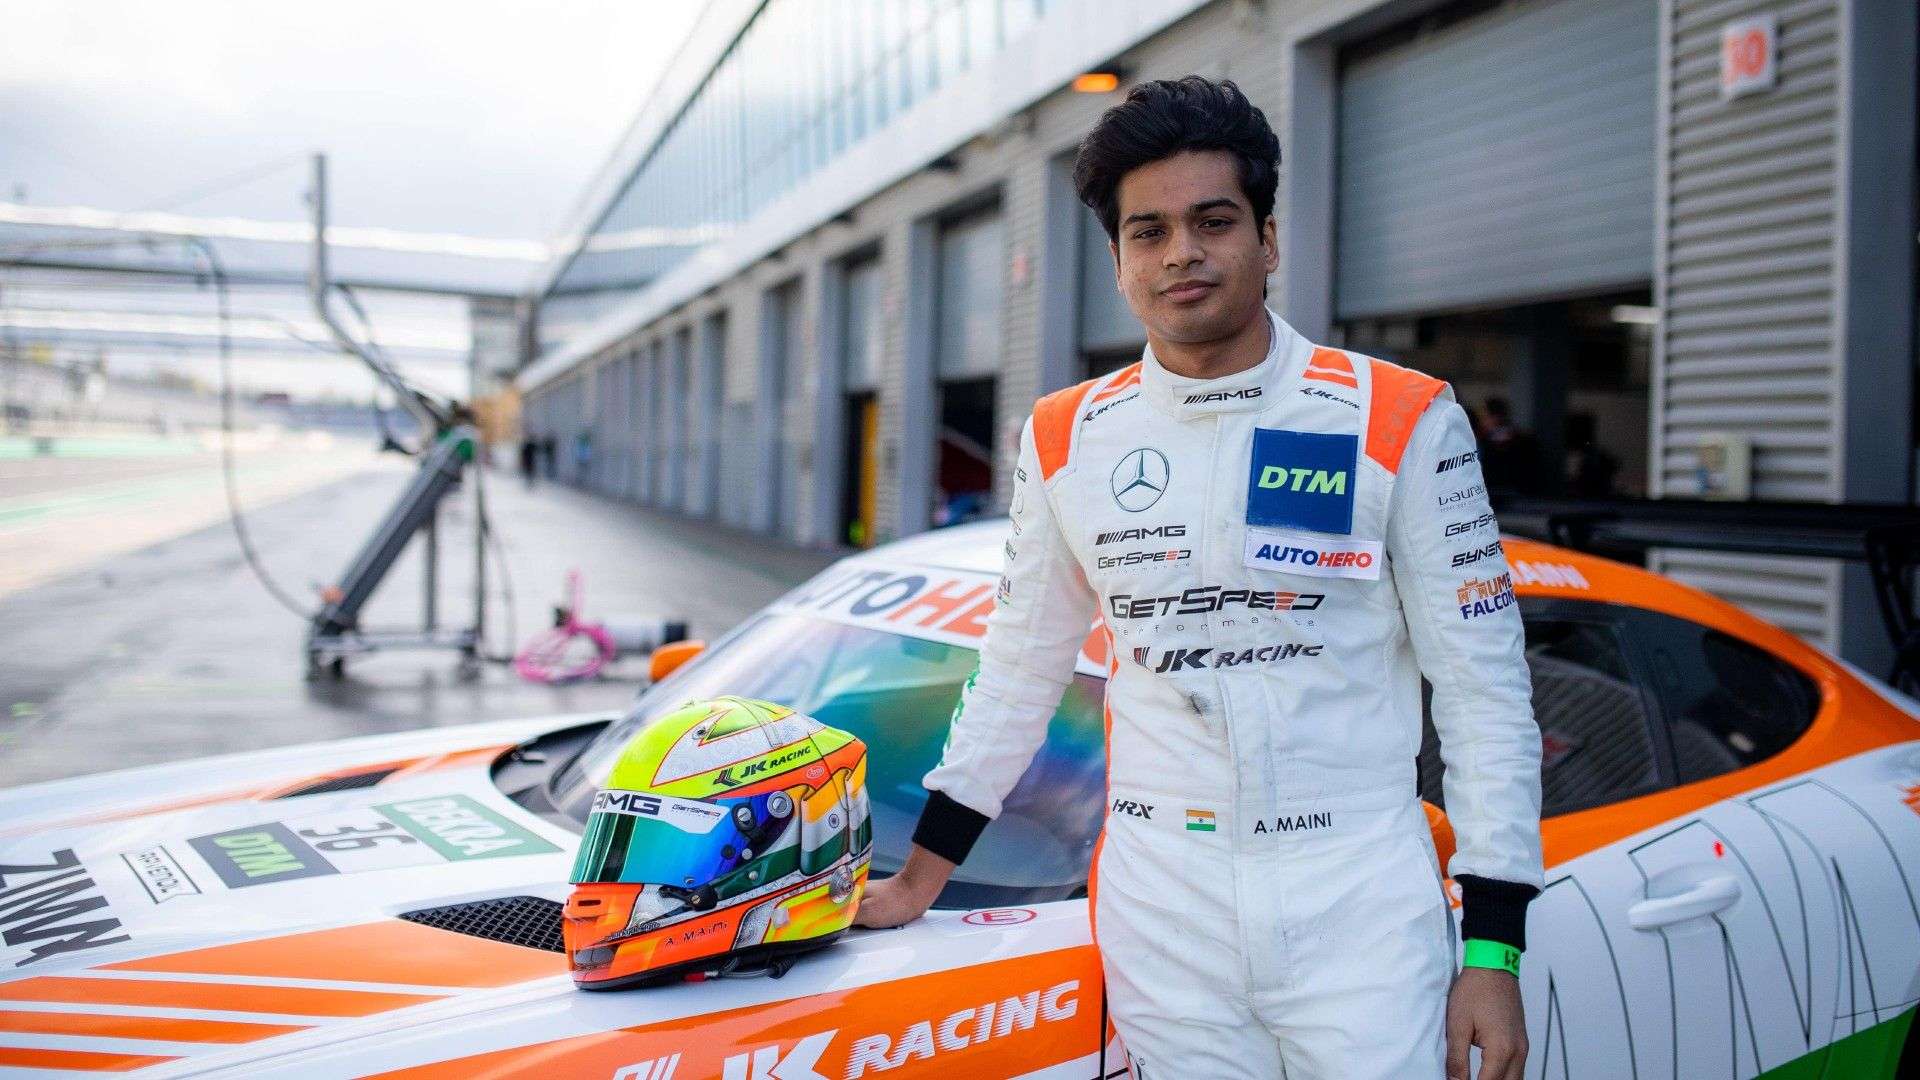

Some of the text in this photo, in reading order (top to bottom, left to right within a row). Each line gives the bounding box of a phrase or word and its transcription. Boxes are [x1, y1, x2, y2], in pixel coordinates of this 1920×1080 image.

[1258, 465, 1347, 495] DTM
[1255, 543, 1373, 569] AUTOHERO
[1452, 541, 1504, 568] SYNER
[1460, 590, 1516, 620] FALCON
[1156, 644, 1324, 673] JK RACING
[740, 746, 811, 778] JK RACING
[1113, 799, 1155, 820] HRX
[299, 821, 417, 851] 36
[214, 831, 304, 878] DTM
[845, 980, 1080, 1080] RACING
